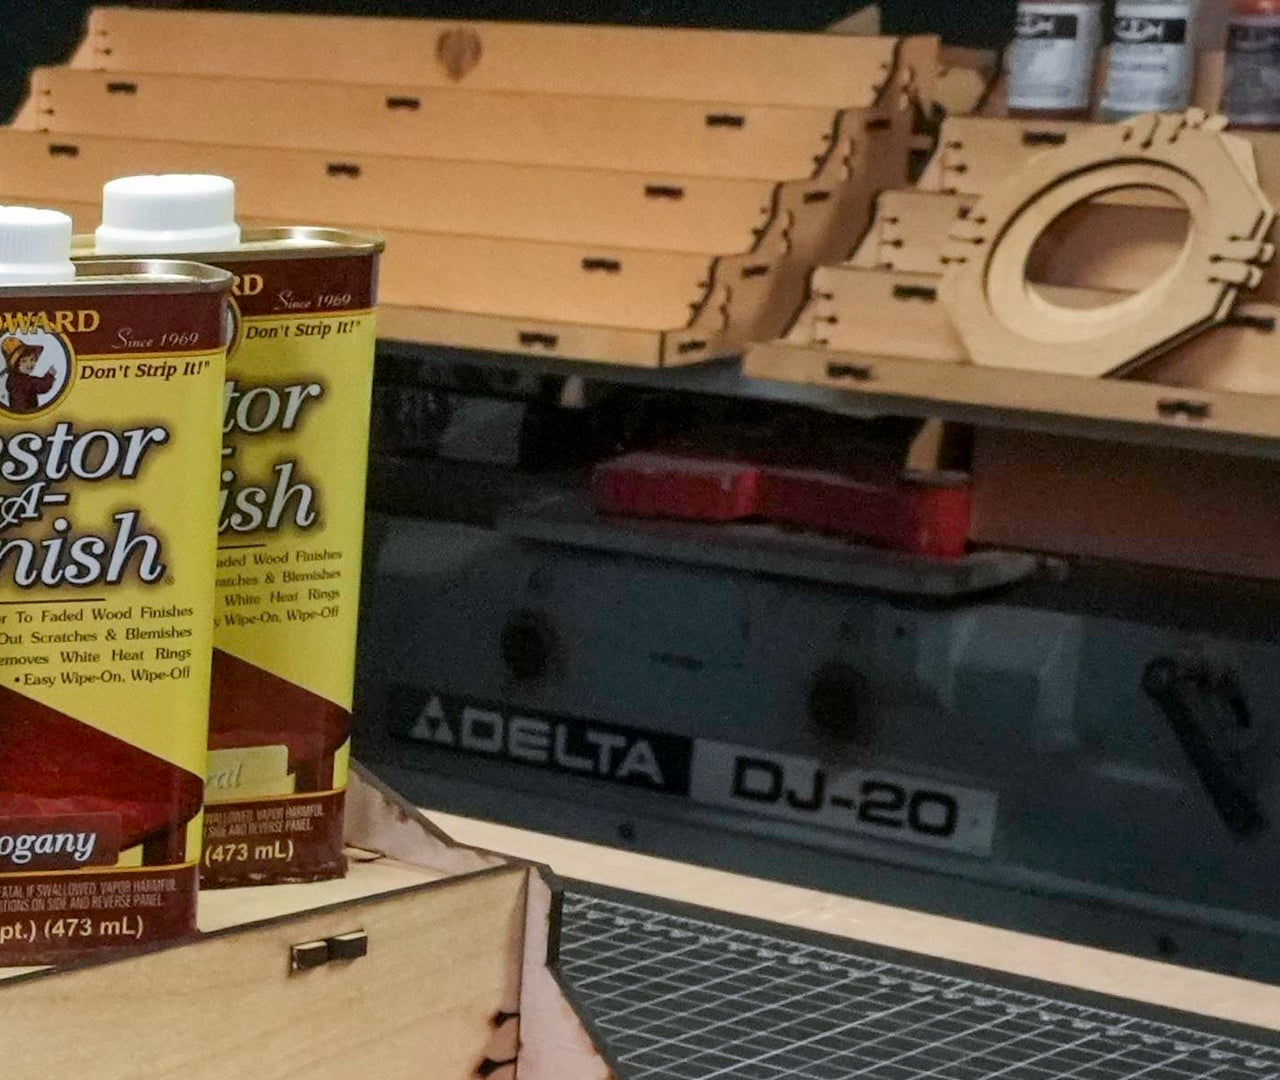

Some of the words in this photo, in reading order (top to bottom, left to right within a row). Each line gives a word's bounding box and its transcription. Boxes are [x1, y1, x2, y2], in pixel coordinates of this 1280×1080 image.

[110, 328, 153, 348] Since
[160, 331, 199, 347] 1969
[246, 325, 290, 340] Don't
[294, 323, 332, 339] Strip
[80, 363, 130, 381] Don't
[135, 361, 178, 382] Strip
[182, 360, 210, 376] It!"
[222, 380, 321, 433] tor
[218, 462, 315, 531] ish
[16, 611, 34, 623] To
[41, 608, 84, 623] Faded
[92, 606, 132, 621] Wood
[140, 605, 193, 619] Finishes
[30, 629, 98, 644] Scratches
[104, 628, 117, 641] &
[125, 625, 192, 640] Blemishes
[60, 650, 101, 664] White
[111, 648, 144, 662] Heat
[155, 646, 191, 662] Rings
[23, 673, 56, 688] Easy
[60, 670, 126, 686] Wipe-On,
[131, 666, 190, 682] Wipe-Off
[461, 708, 665, 785] DELTA
[730, 755, 959, 838] DJ-20
[205, 844, 248, 867] (473
[254, 839, 293, 862] mL)
[0, 918, 37, 944] pt.)
[43, 917, 92, 941] (473
[99, 914, 144, 937] mL)
